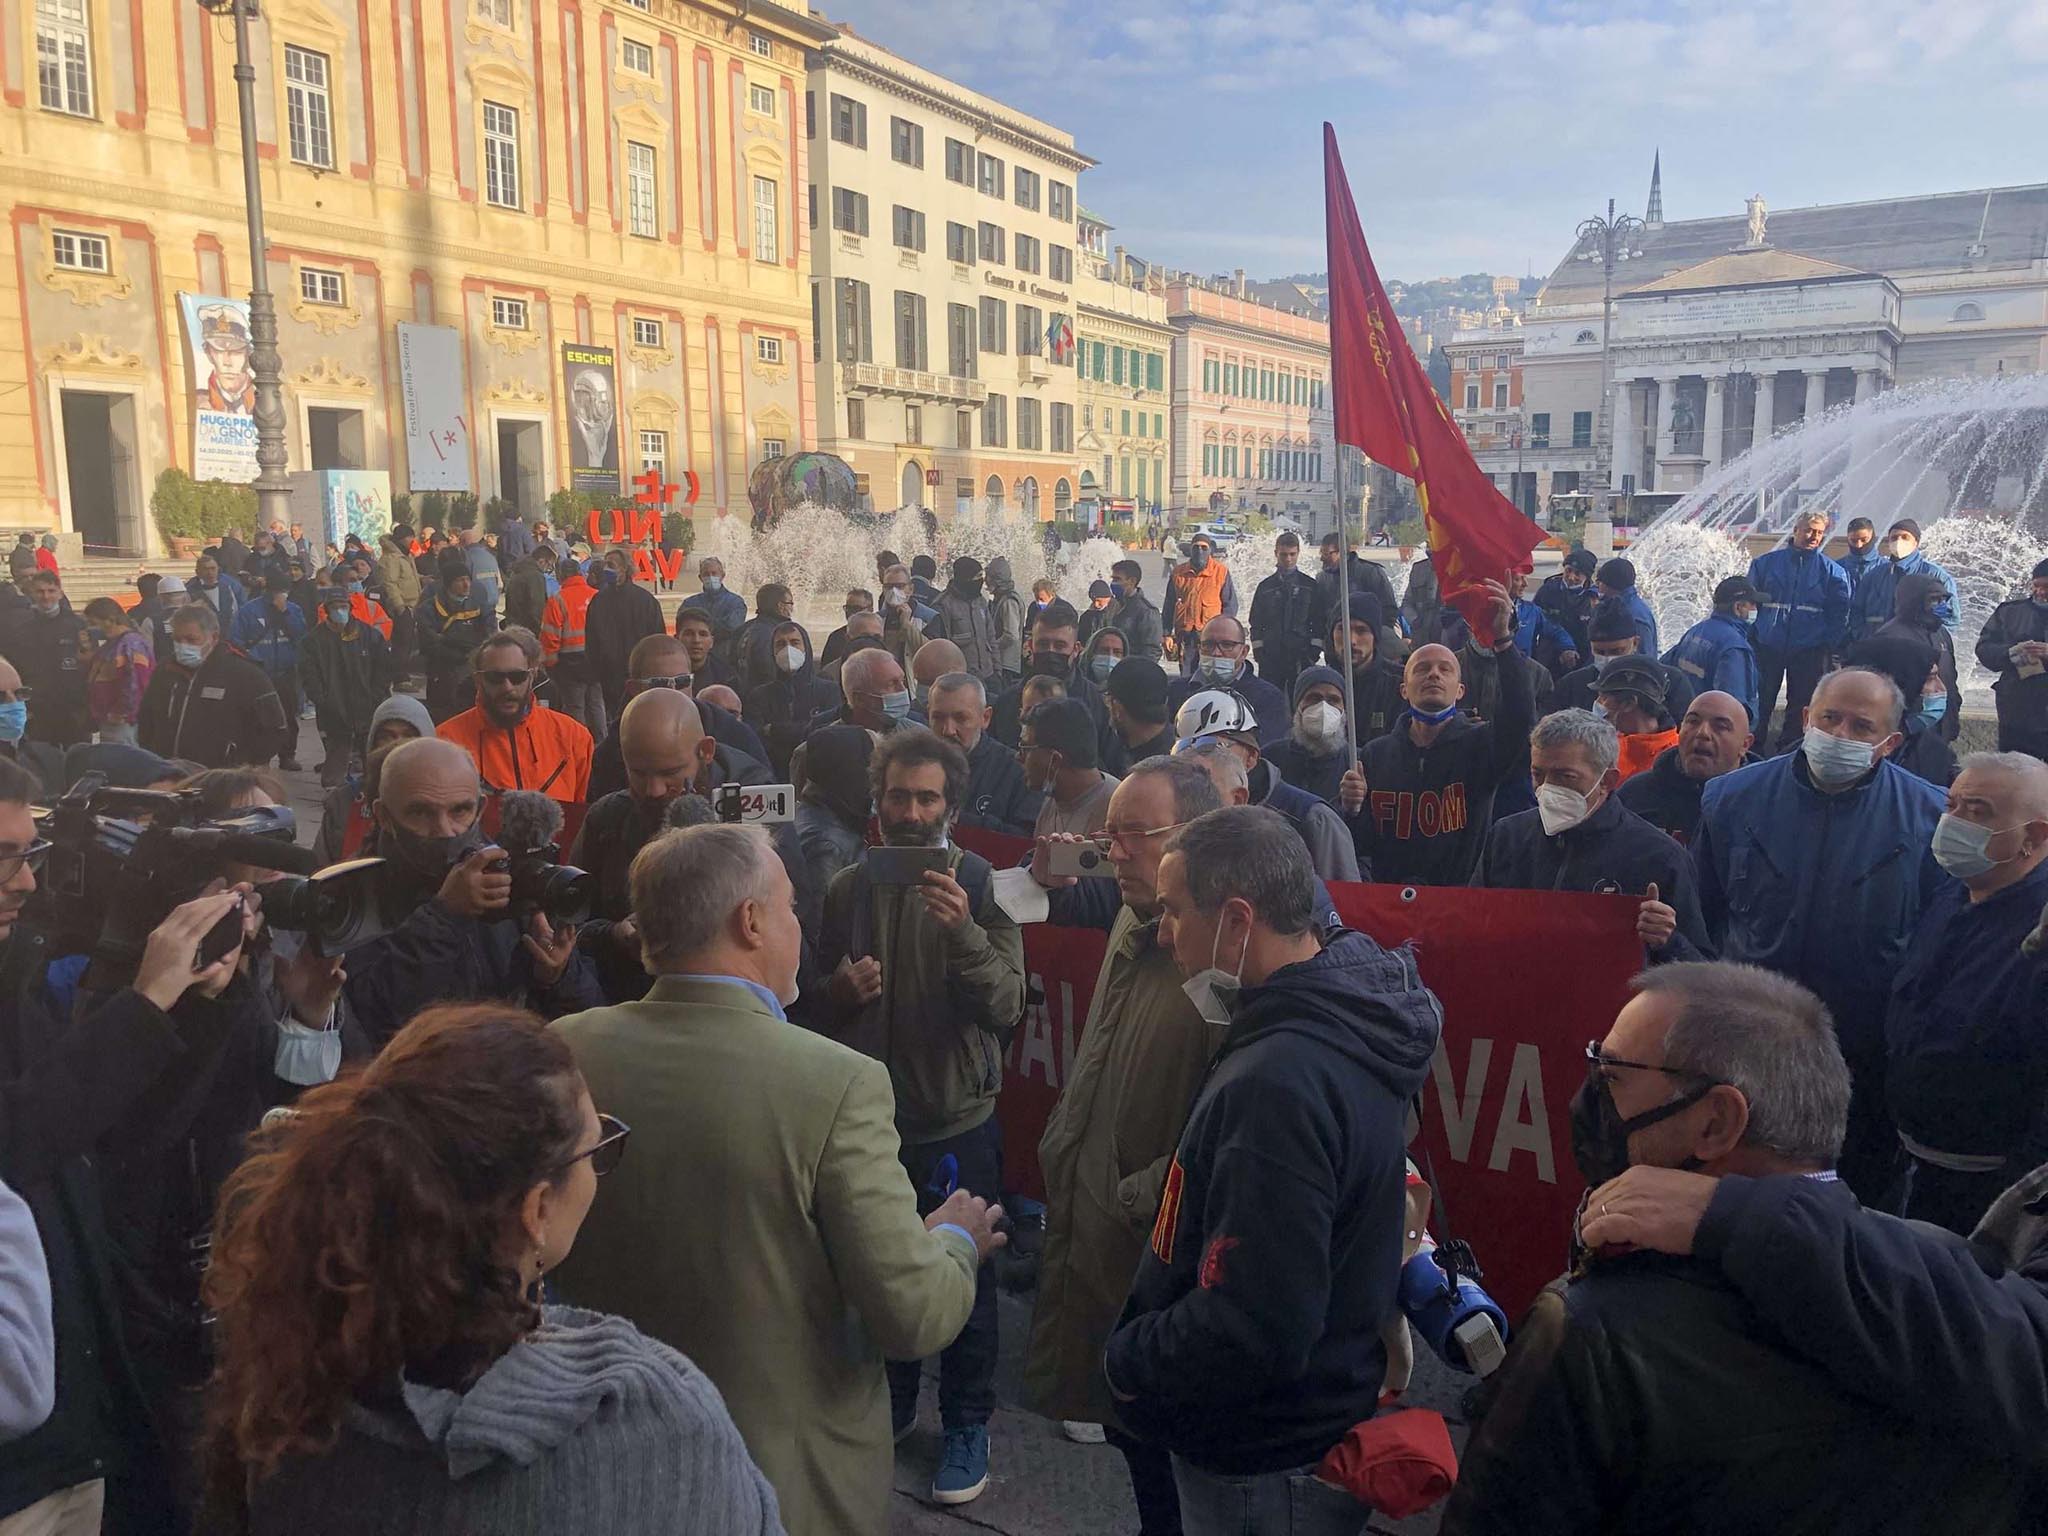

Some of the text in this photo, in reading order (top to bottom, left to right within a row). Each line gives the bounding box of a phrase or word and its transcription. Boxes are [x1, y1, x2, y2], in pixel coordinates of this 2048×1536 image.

[566, 350, 613, 367] ESCHER
[402, 333, 417, 438] Festival della Scienza
[219, 426, 258, 439] GENOV
[233, 417, 256, 429] PRA
[1370, 782, 1467, 840] FIOM
[1406, 1036, 1558, 1185] VA
